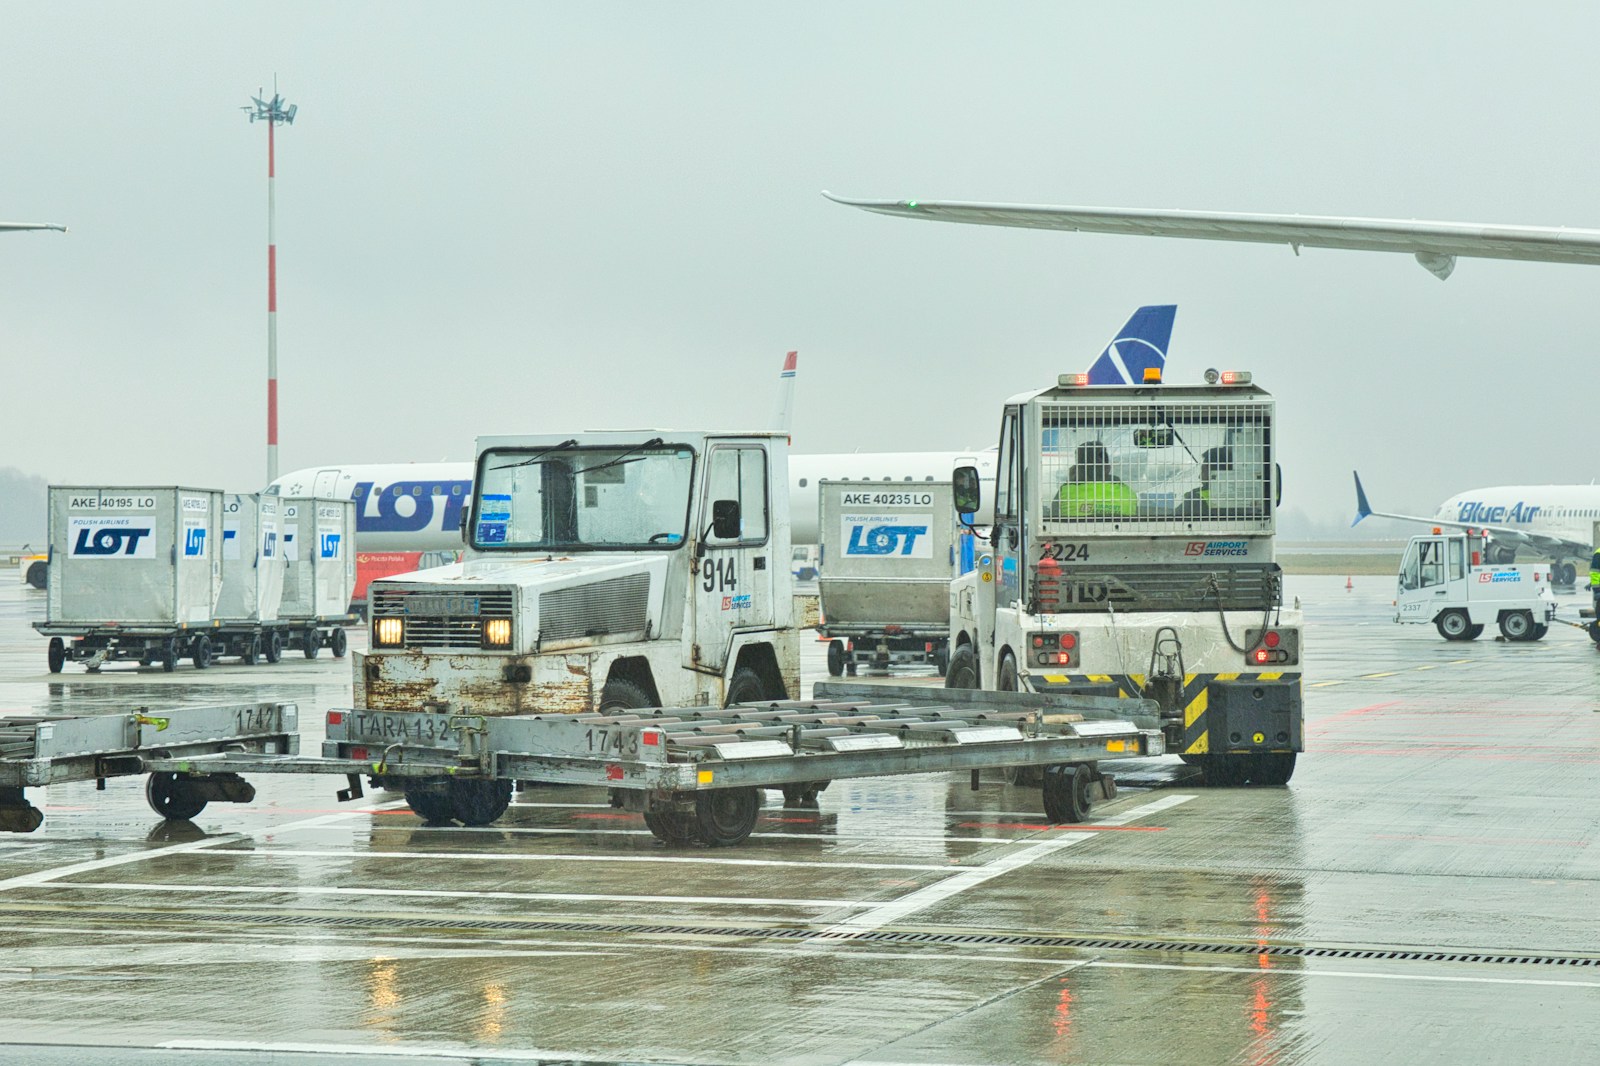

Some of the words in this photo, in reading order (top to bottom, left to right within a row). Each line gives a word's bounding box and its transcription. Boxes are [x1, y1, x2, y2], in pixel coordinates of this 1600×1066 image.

[71, 498, 96, 508] AKE
[101, 498, 133, 508] 40195
[138, 498, 154, 507] LO
[351, 480, 473, 532] LOT
[842, 494, 871, 504] AKE
[873, 494, 911, 504] 40235
[913, 494, 931, 505] LO
[1457, 502, 1505, 523] Blue
[1506, 501, 1541, 523] Air
[73, 528, 151, 555] LOT
[185, 528, 206, 556] LOT
[321, 534, 341, 558] LOT
[846, 525, 928, 555] LOT
[1206, 541, 1248, 549] AIRPORT
[703, 557, 737, 593] 914
[731, 602, 752, 610] SERVICES
[237, 707, 273, 731] 1742
[357, 714, 409, 738] TARA
[414, 718, 461, 743] 132
[585, 728, 638, 754] 1743
